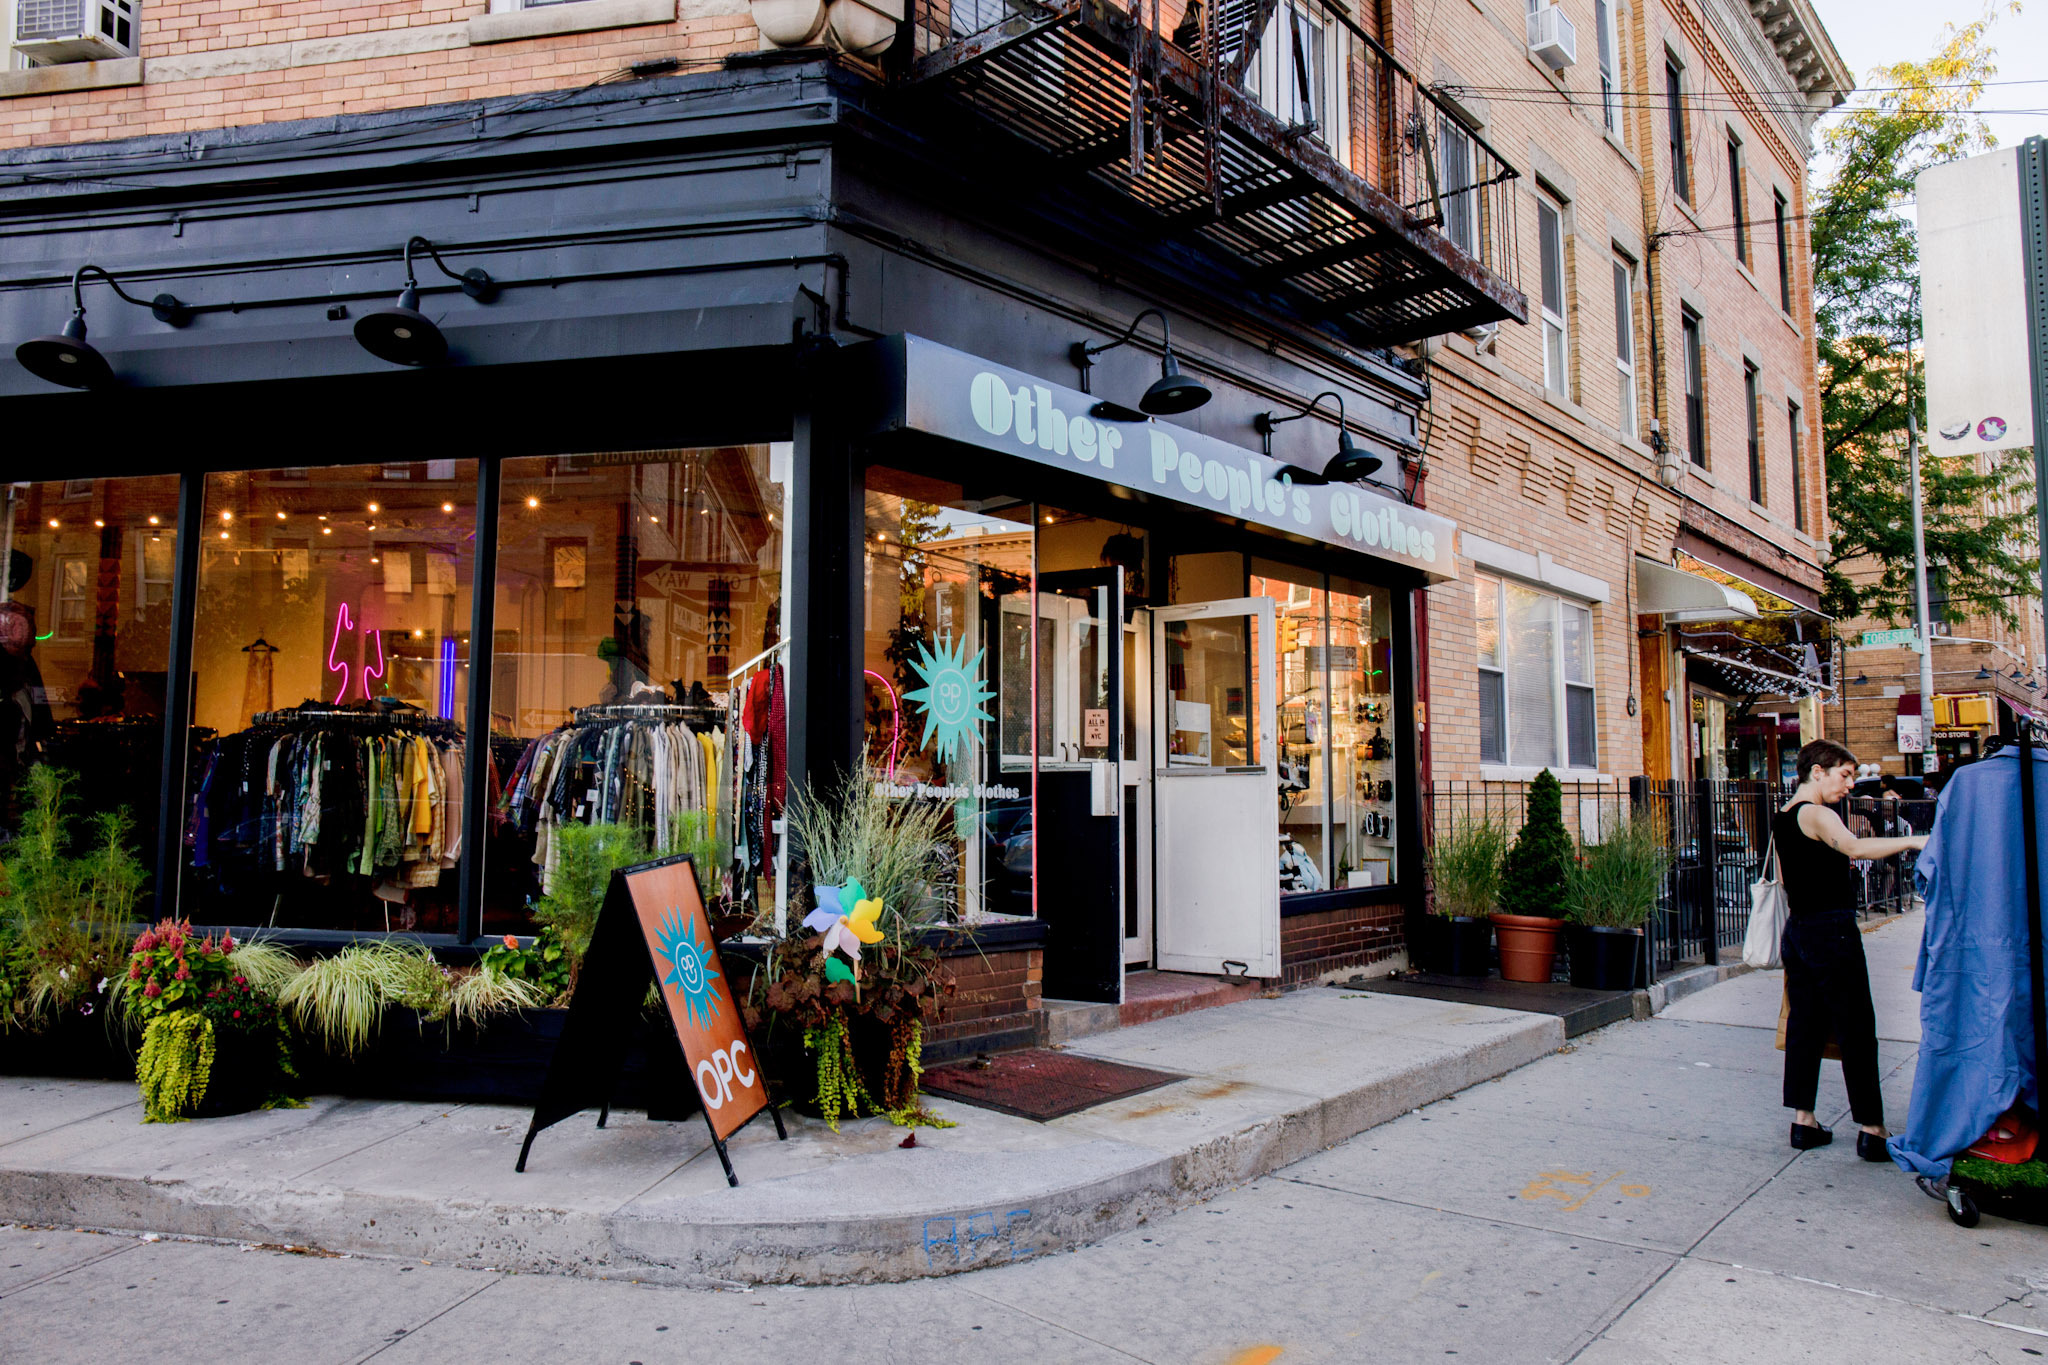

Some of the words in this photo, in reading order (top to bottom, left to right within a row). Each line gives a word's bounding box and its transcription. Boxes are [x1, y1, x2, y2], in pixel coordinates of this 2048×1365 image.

[970, 372, 1122, 469] Other
[1150, 427, 1312, 527] People's
[1330, 491, 1436, 564] Clothes
[1864, 631, 1905, 644] FOREST
[1948, 731, 1970, 739] STORE
[973, 783, 1020, 799] Clothes
[696, 1039, 755, 1110] OPC
